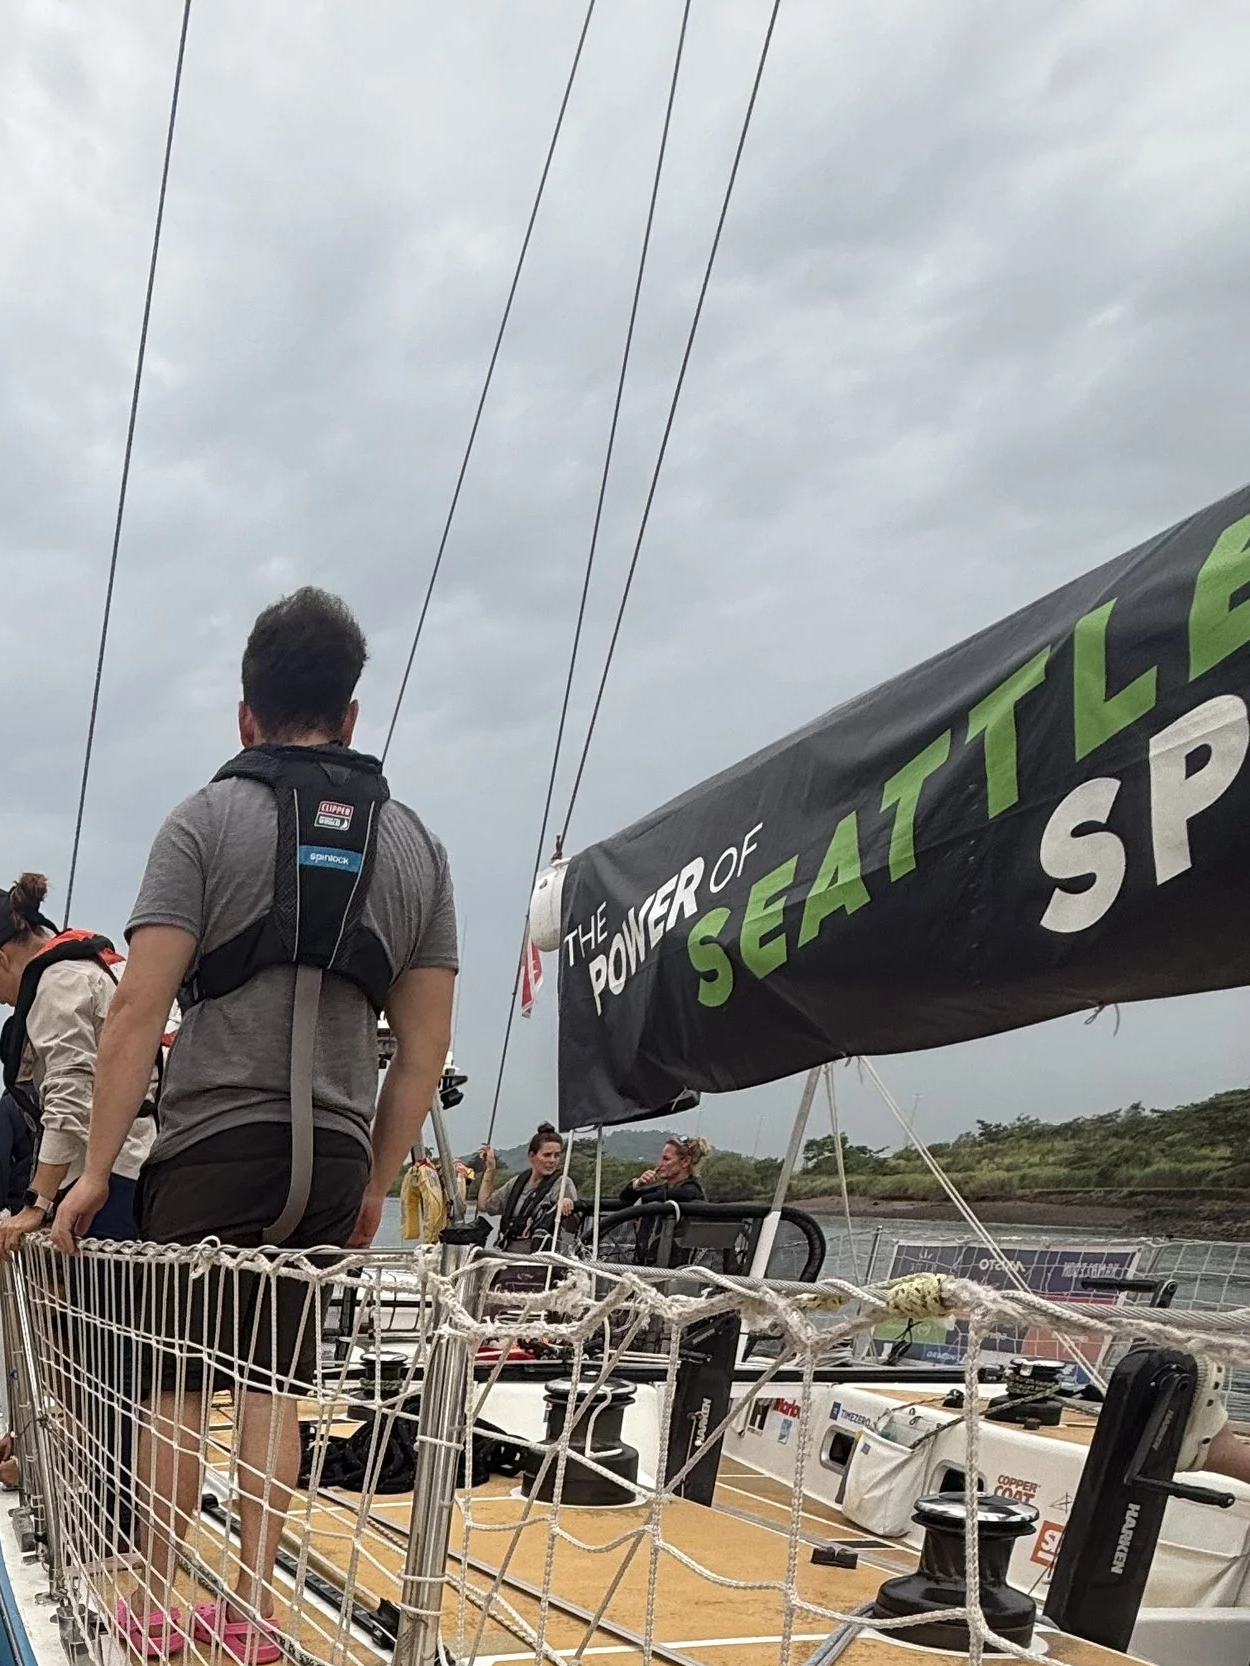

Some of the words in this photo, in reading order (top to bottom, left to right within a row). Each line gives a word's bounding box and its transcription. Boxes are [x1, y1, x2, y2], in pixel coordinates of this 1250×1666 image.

[687, 514, 1250, 1007] SEATTLE
[321, 803, 351, 816] CLIPPER
[1039, 695, 1249, 935] SP
[310, 852, 349, 865] spinlock
[563, 901, 607, 967] THE
[588, 857, 705, 1016] POWER
[709, 822, 763, 893] OF
[841, 1409, 872, 1427] TIMEZERO
[997, 1474, 1038, 1493] COPPER
[1110, 1503, 1141, 1575] HARKEN
